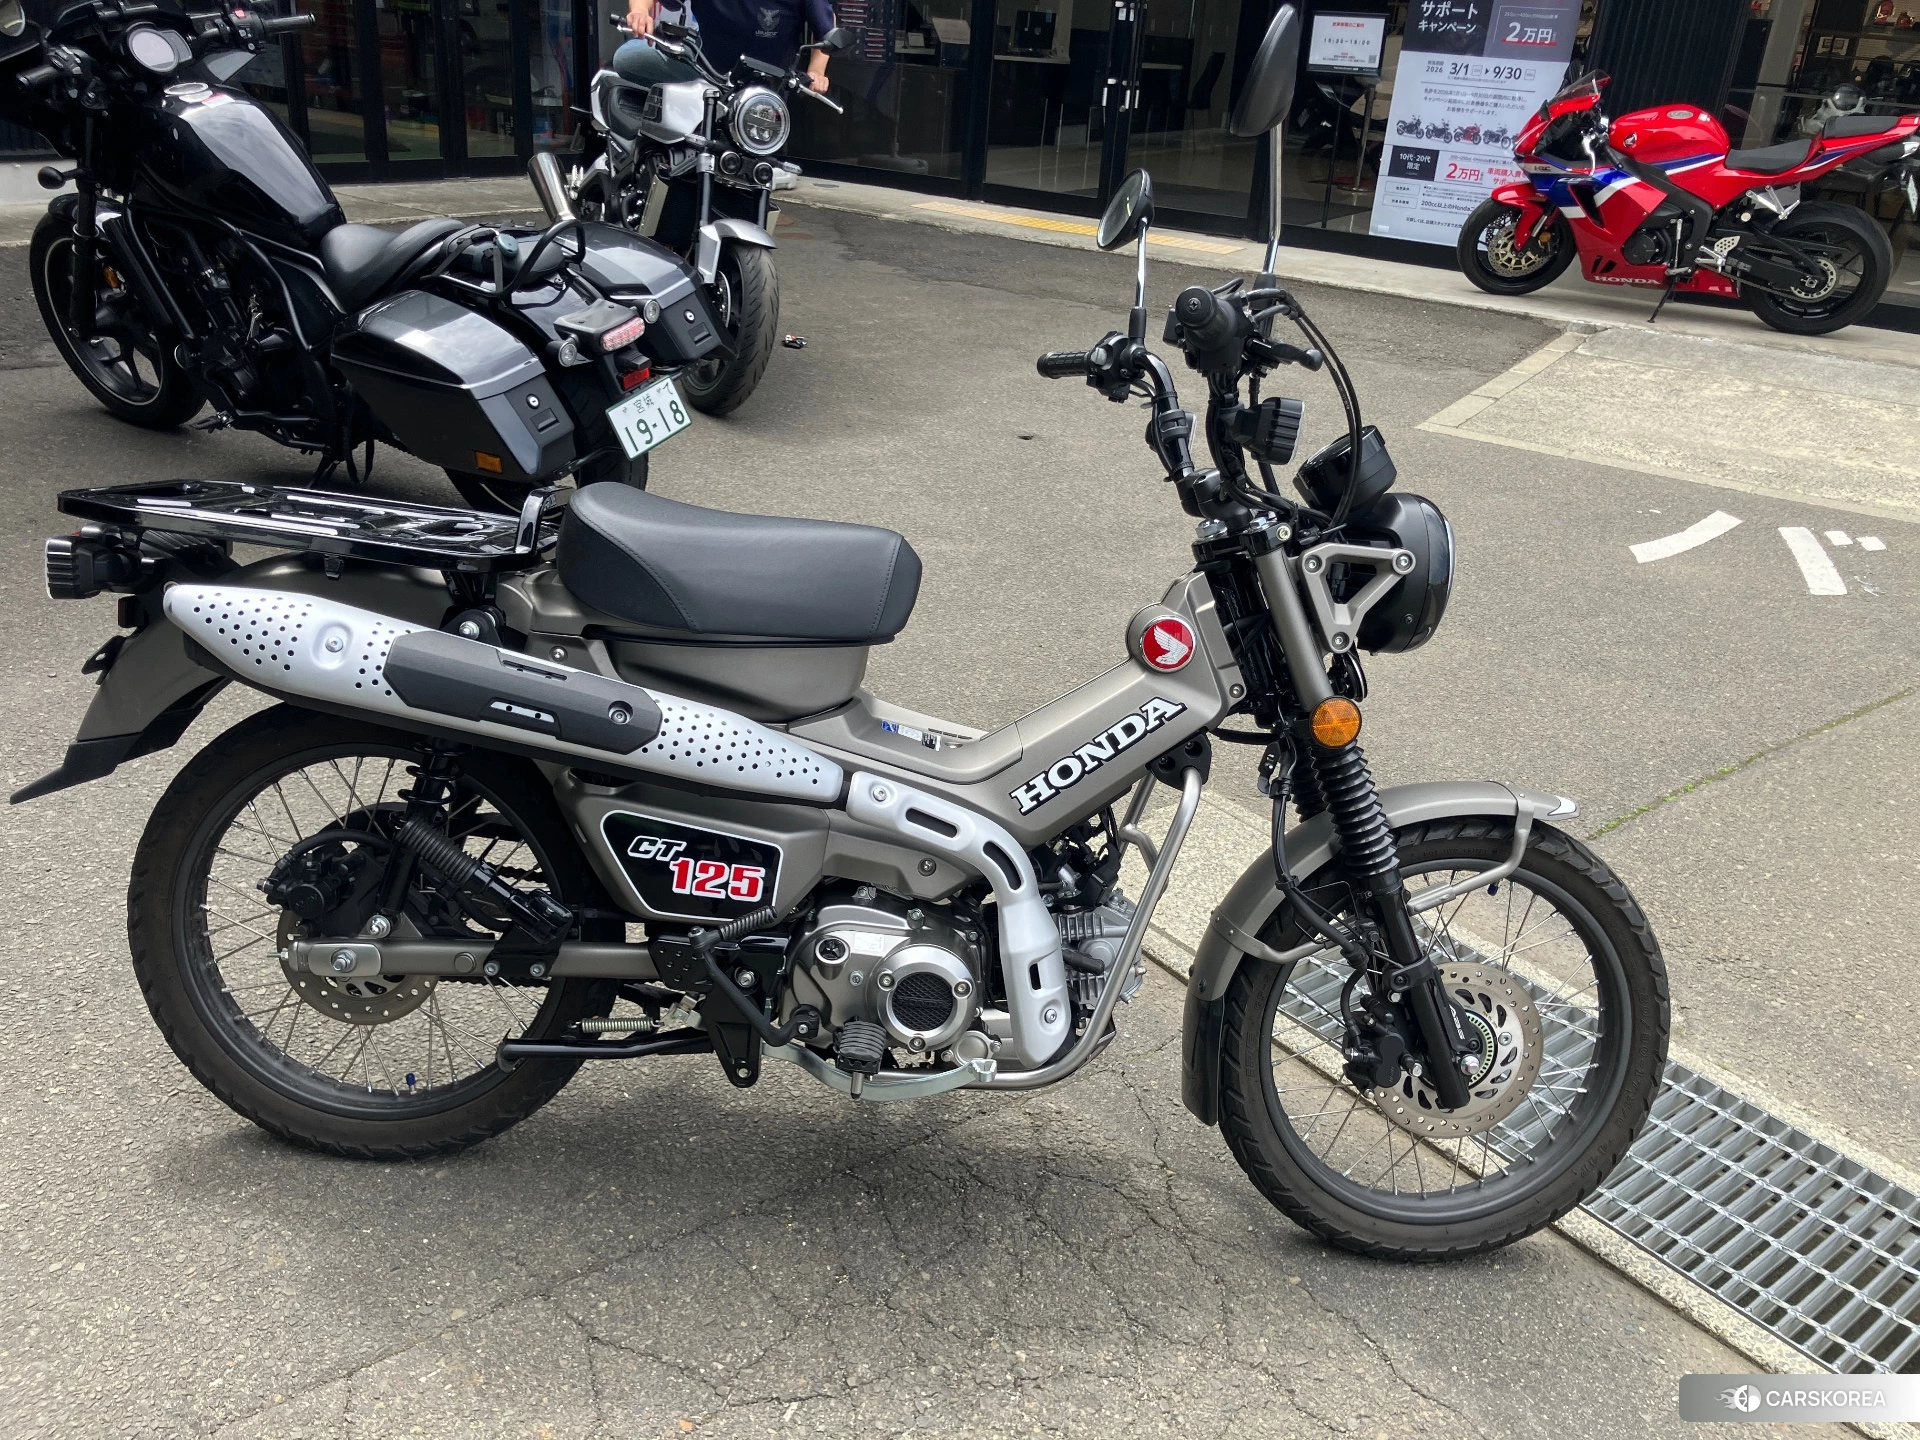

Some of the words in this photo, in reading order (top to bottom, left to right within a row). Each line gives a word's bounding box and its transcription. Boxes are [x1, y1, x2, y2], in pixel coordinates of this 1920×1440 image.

[1421, 0, 1478, 20] サポート
[1418, 19, 1477, 34] キャンペーン
[1506, 21, 1552, 44] 2万円
[1449, 62, 1470, 76] 3/1
[1493, 65, 1522, 80] 9/30
[1406, 162, 1421, 171] 限定
[1445, 162, 1481, 182] 2万円
[1593, 275, 1661, 285] HONDA
[1010, 697, 1188, 816] HONDA
[627, 835, 688, 862] CT
[669, 857, 766, 903] 125
